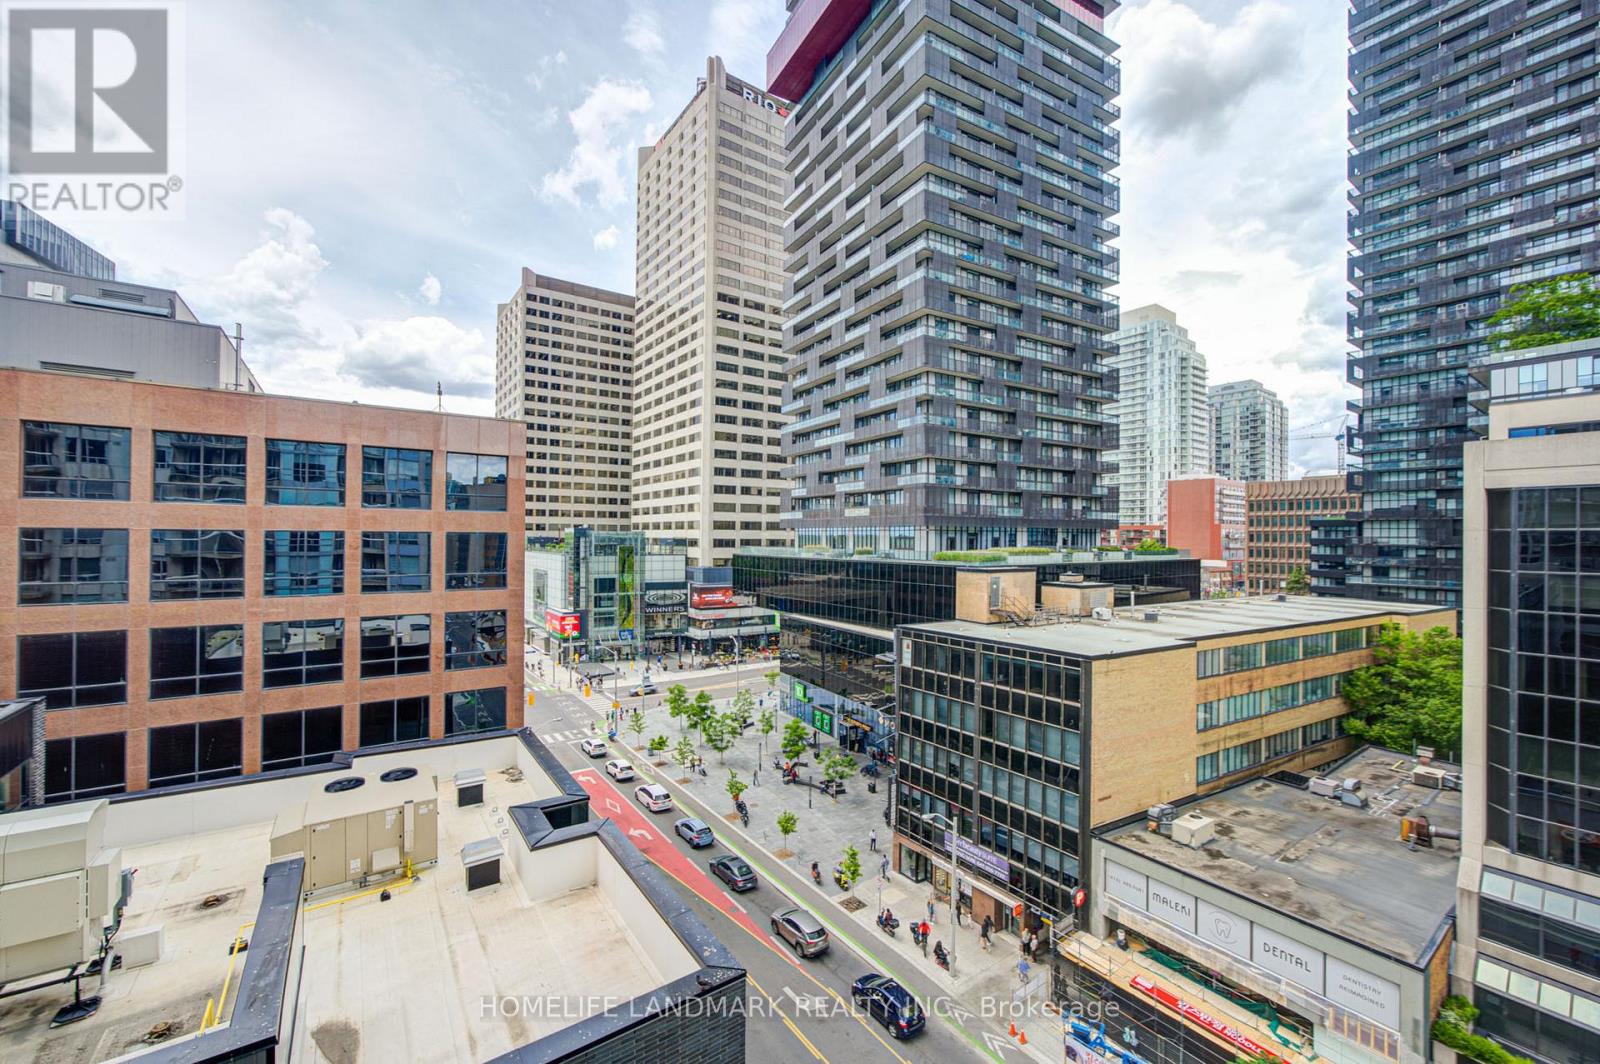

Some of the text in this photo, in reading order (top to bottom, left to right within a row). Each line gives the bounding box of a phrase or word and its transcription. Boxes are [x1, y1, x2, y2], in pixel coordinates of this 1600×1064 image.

[645, 605, 685, 613] WINNERS
[1152, 892, 1191, 917] MALEKI
[1263, 942, 1312, 973] DENTAL
[1338, 983, 1386, 1009] REIMAGINED
[1342, 974, 1382, 995] DENTISTRY
